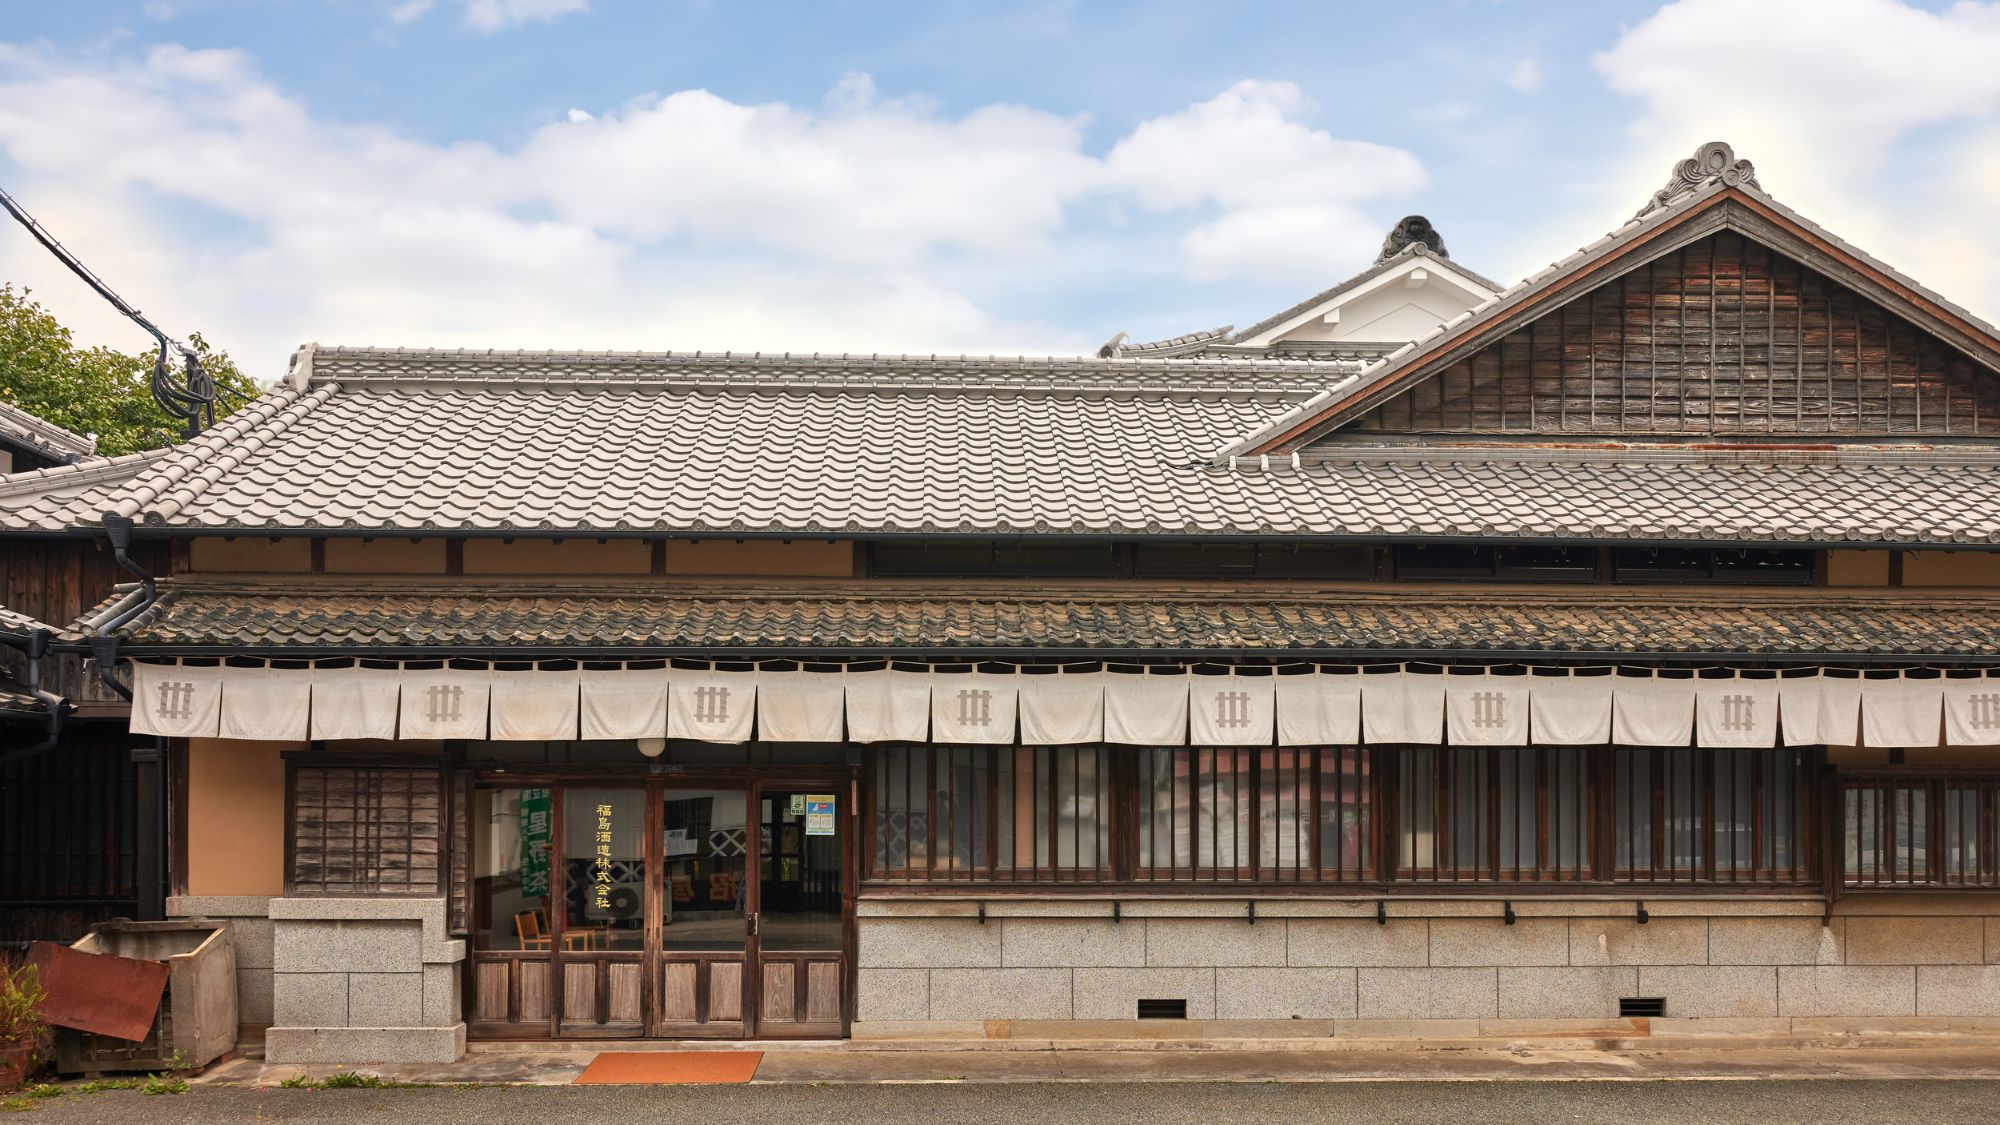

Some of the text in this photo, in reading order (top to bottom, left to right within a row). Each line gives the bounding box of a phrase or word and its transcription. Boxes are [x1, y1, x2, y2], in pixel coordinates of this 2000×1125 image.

[595, 804, 612, 909] 福島酒造株式会社
